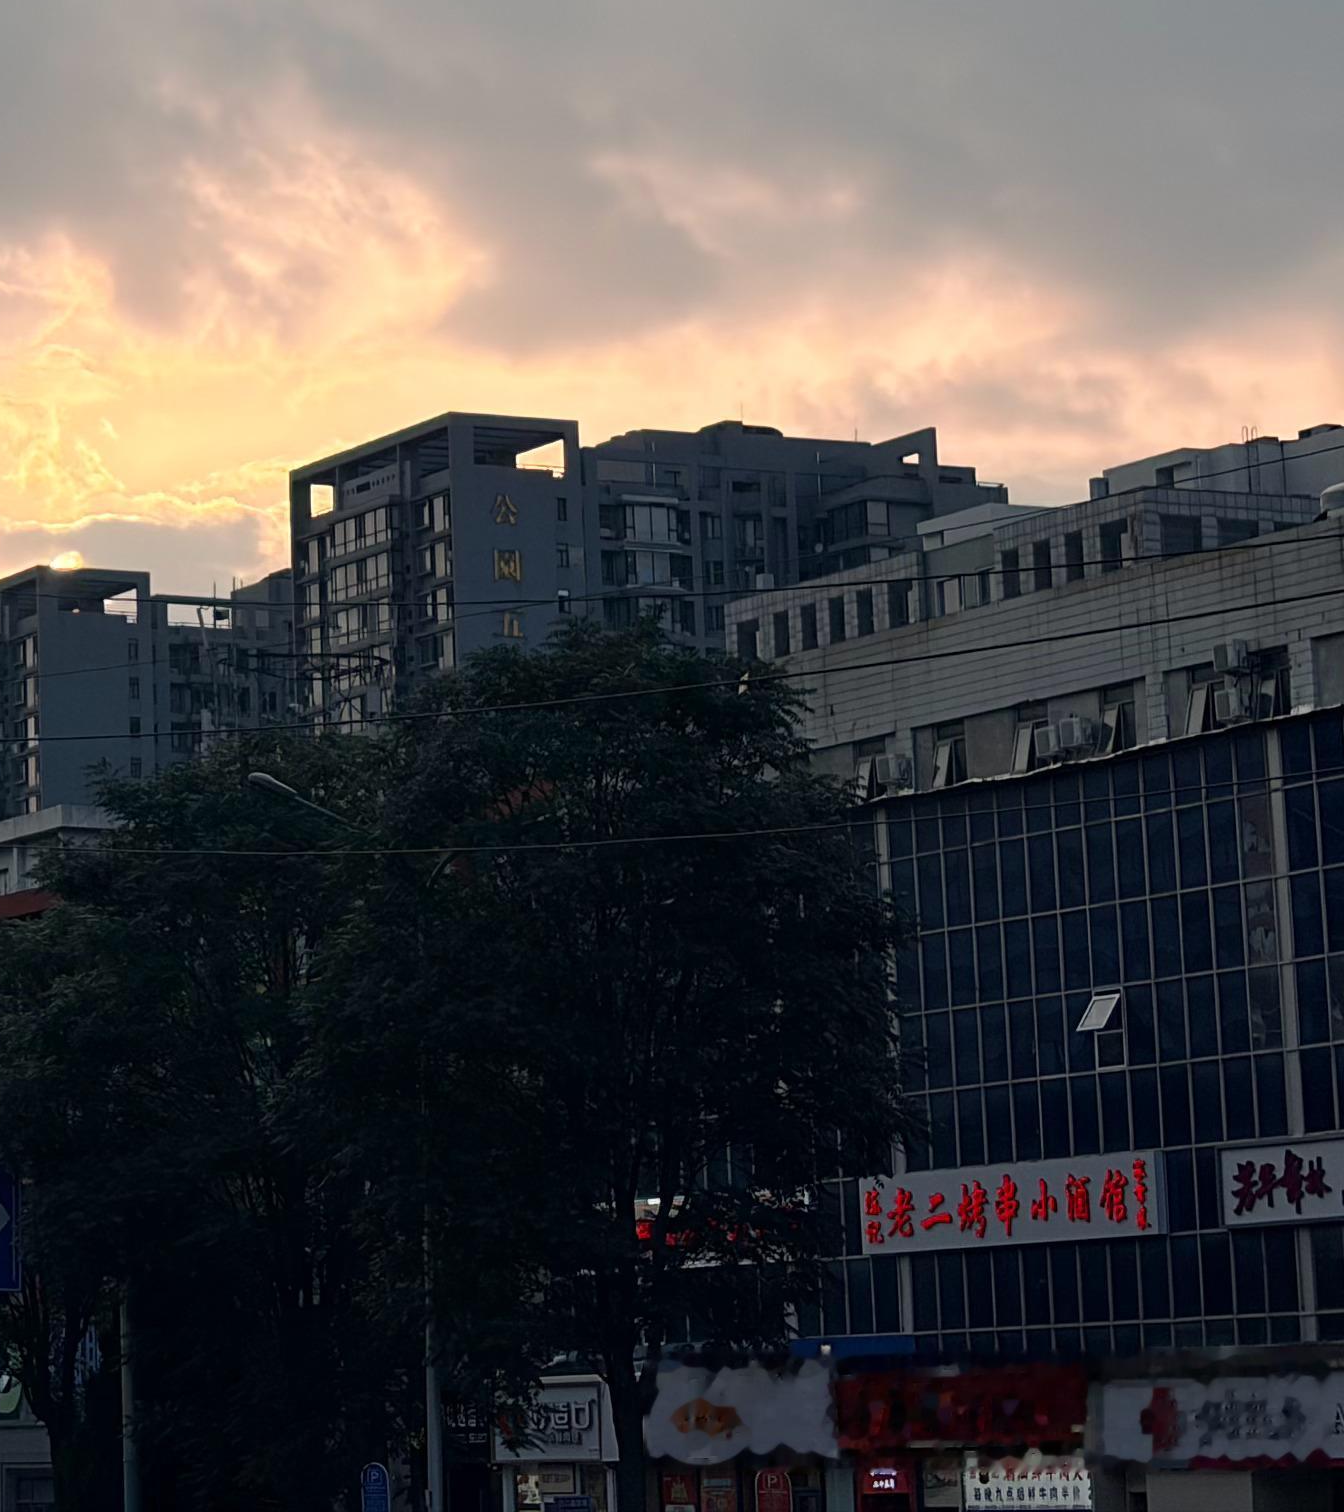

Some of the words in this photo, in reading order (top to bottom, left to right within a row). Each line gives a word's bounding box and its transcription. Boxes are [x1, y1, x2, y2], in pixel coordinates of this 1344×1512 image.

[887, 1169, 1129, 1238] 老二烤串小酒馆
[767, 1474, 778, 1488] P
